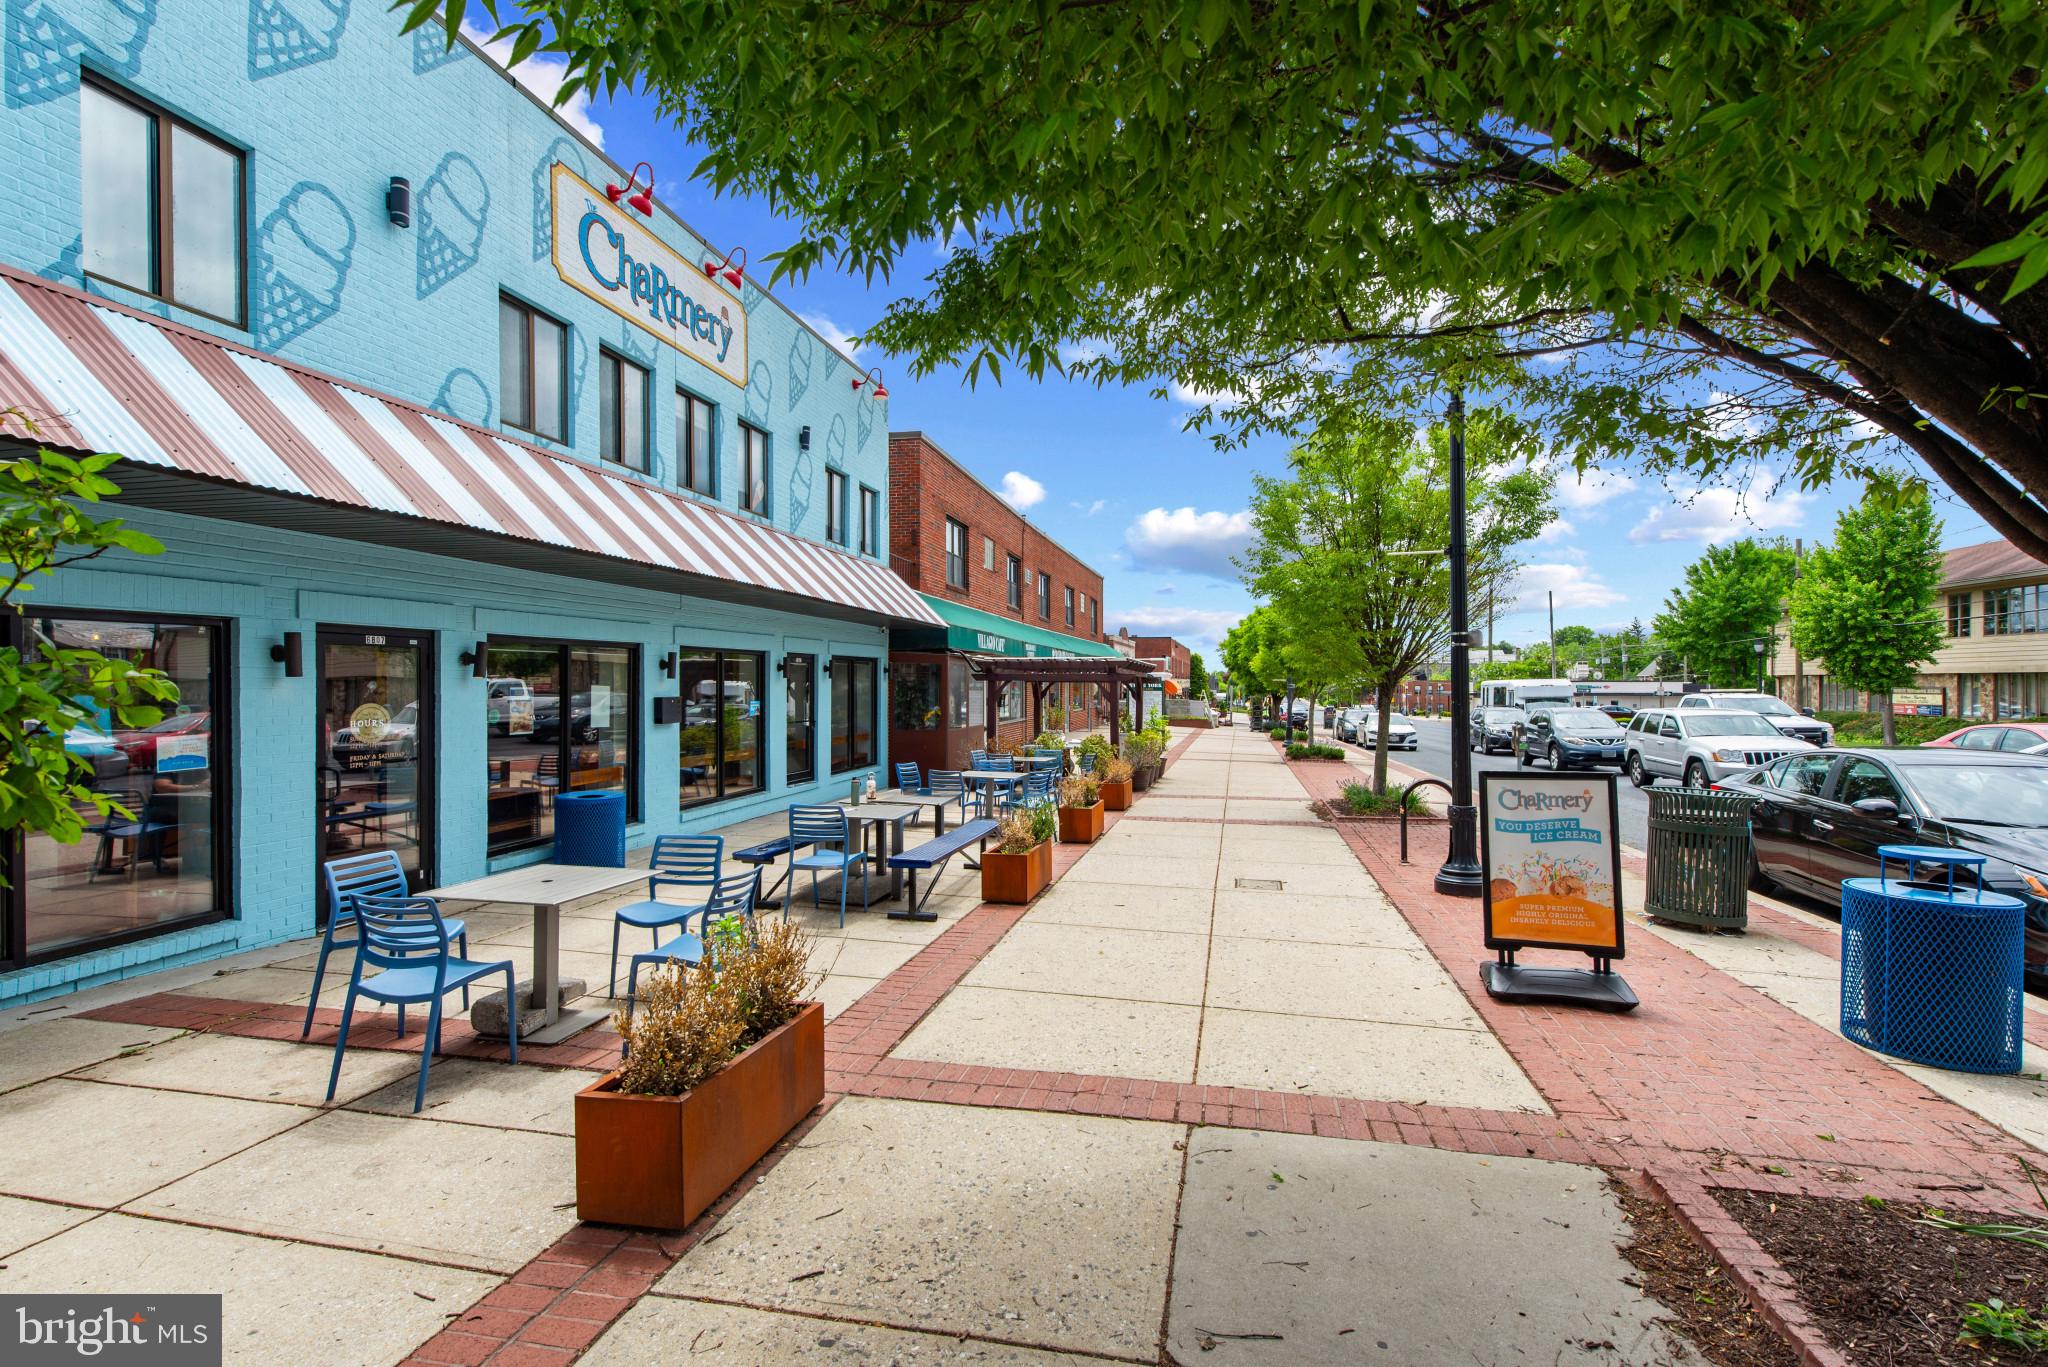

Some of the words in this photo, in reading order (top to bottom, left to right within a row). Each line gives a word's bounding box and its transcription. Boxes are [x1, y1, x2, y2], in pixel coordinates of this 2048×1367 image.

[366, 635, 385, 645] 6807
[350, 719, 385, 728] HOURS
[349, 754, 370, 762] FRIDAY
[1498, 821, 1522, 831] YOU
[1526, 820, 1577, 831] DESERVE
[1534, 832, 1553, 841] ICE
[1556, 831, 1599, 841] CREAM
[1516, 910, 1547, 918] HIGHLY
[1510, 917, 1549, 925] INSANELY
[1551, 919, 1596, 928] DELICIOUS
